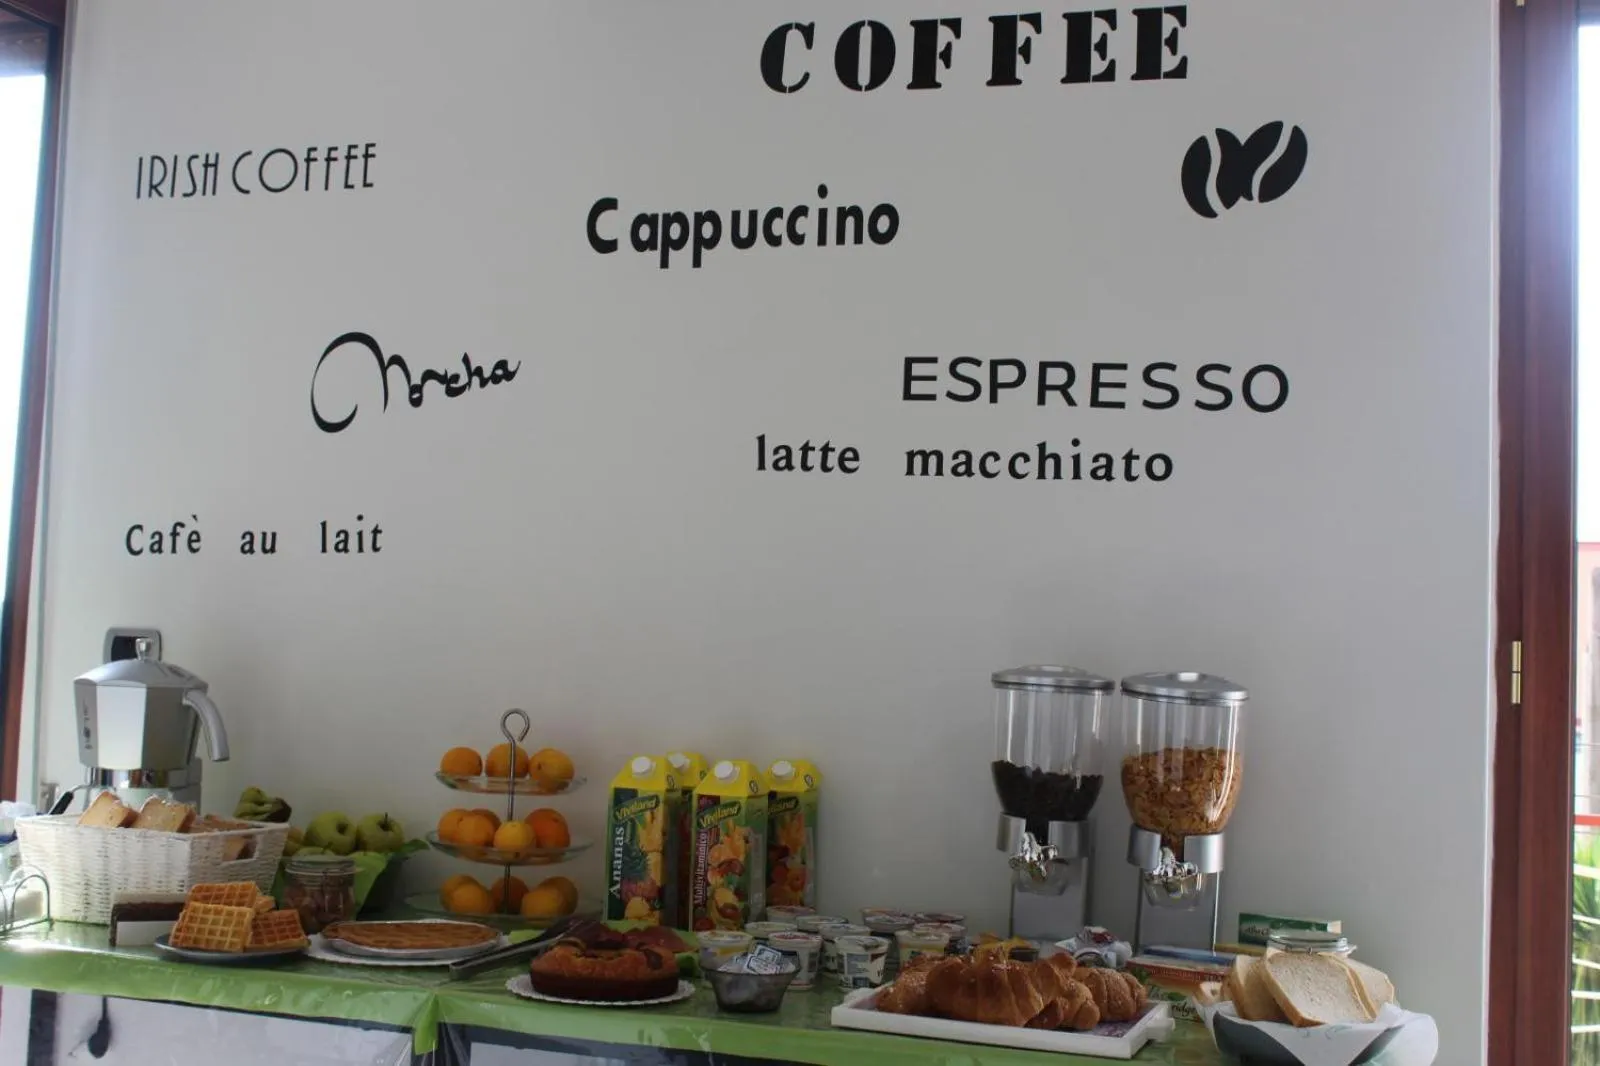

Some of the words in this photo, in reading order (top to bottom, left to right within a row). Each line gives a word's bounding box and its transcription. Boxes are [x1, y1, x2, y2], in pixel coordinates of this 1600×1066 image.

[760, 4, 1189, 94] COFFEE
[136, 152, 220, 199] IRISH
[231, 142, 377, 195] COFFEE
[586, 183, 900, 270] Cappuccino
[310, 331, 522, 434] Mocha
[902, 356, 1290, 414] ESPRESSO
[756, 433, 860, 474] latte
[905, 437, 1174, 482] macchiato
[125, 514, 202, 556] Cafè
[240, 530, 277, 555] au
[320, 514, 384, 554] lait
[608, 826, 625, 900] Ananas
